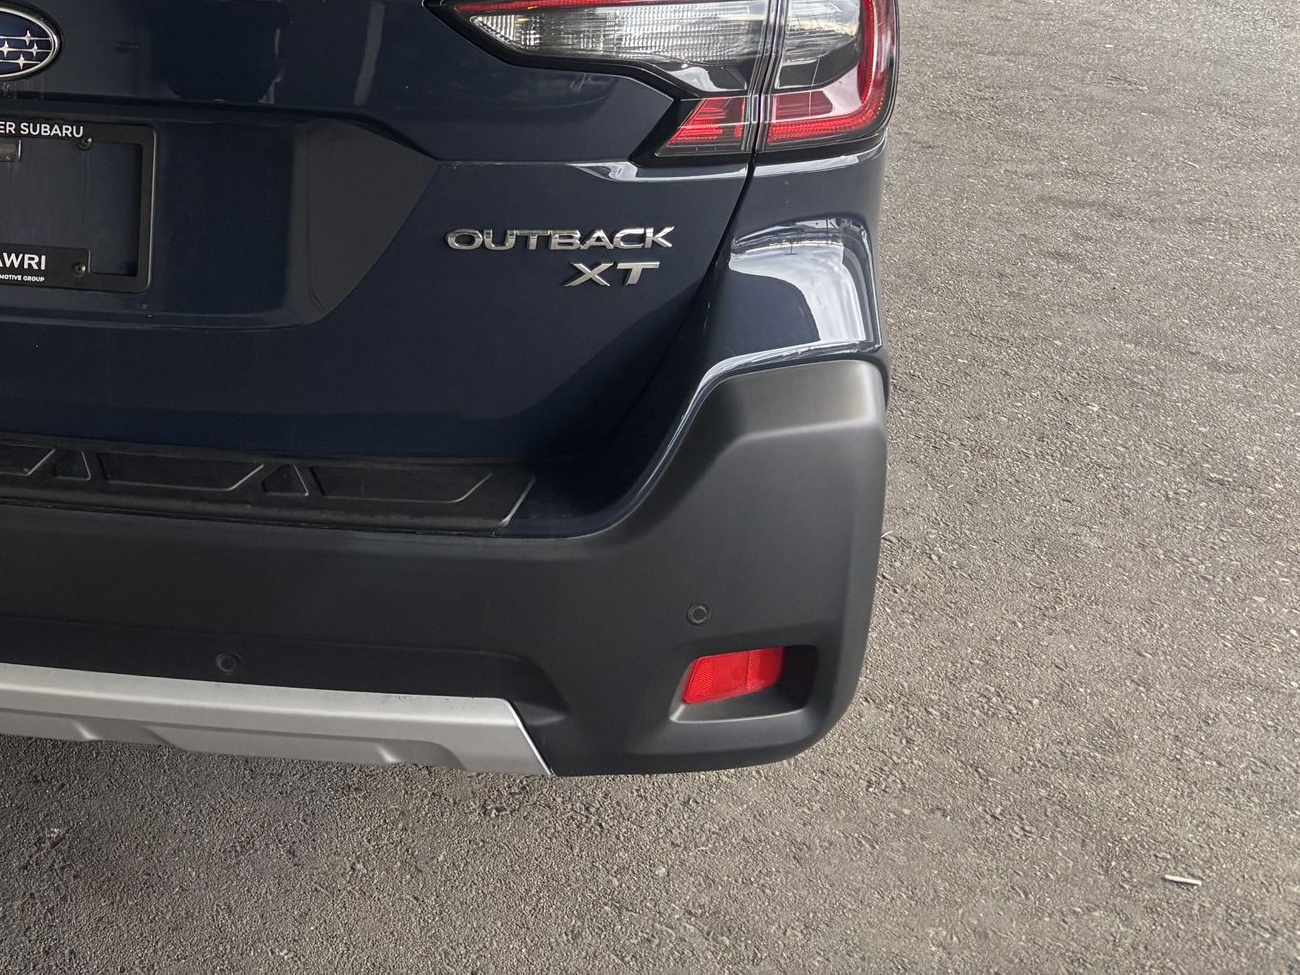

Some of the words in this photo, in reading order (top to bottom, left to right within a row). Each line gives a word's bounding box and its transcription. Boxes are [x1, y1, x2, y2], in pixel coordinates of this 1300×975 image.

[20, 122, 84, 139] SUBARU
[446, 226, 675, 251] OUTBACK
[563, 261, 661, 288] XT
